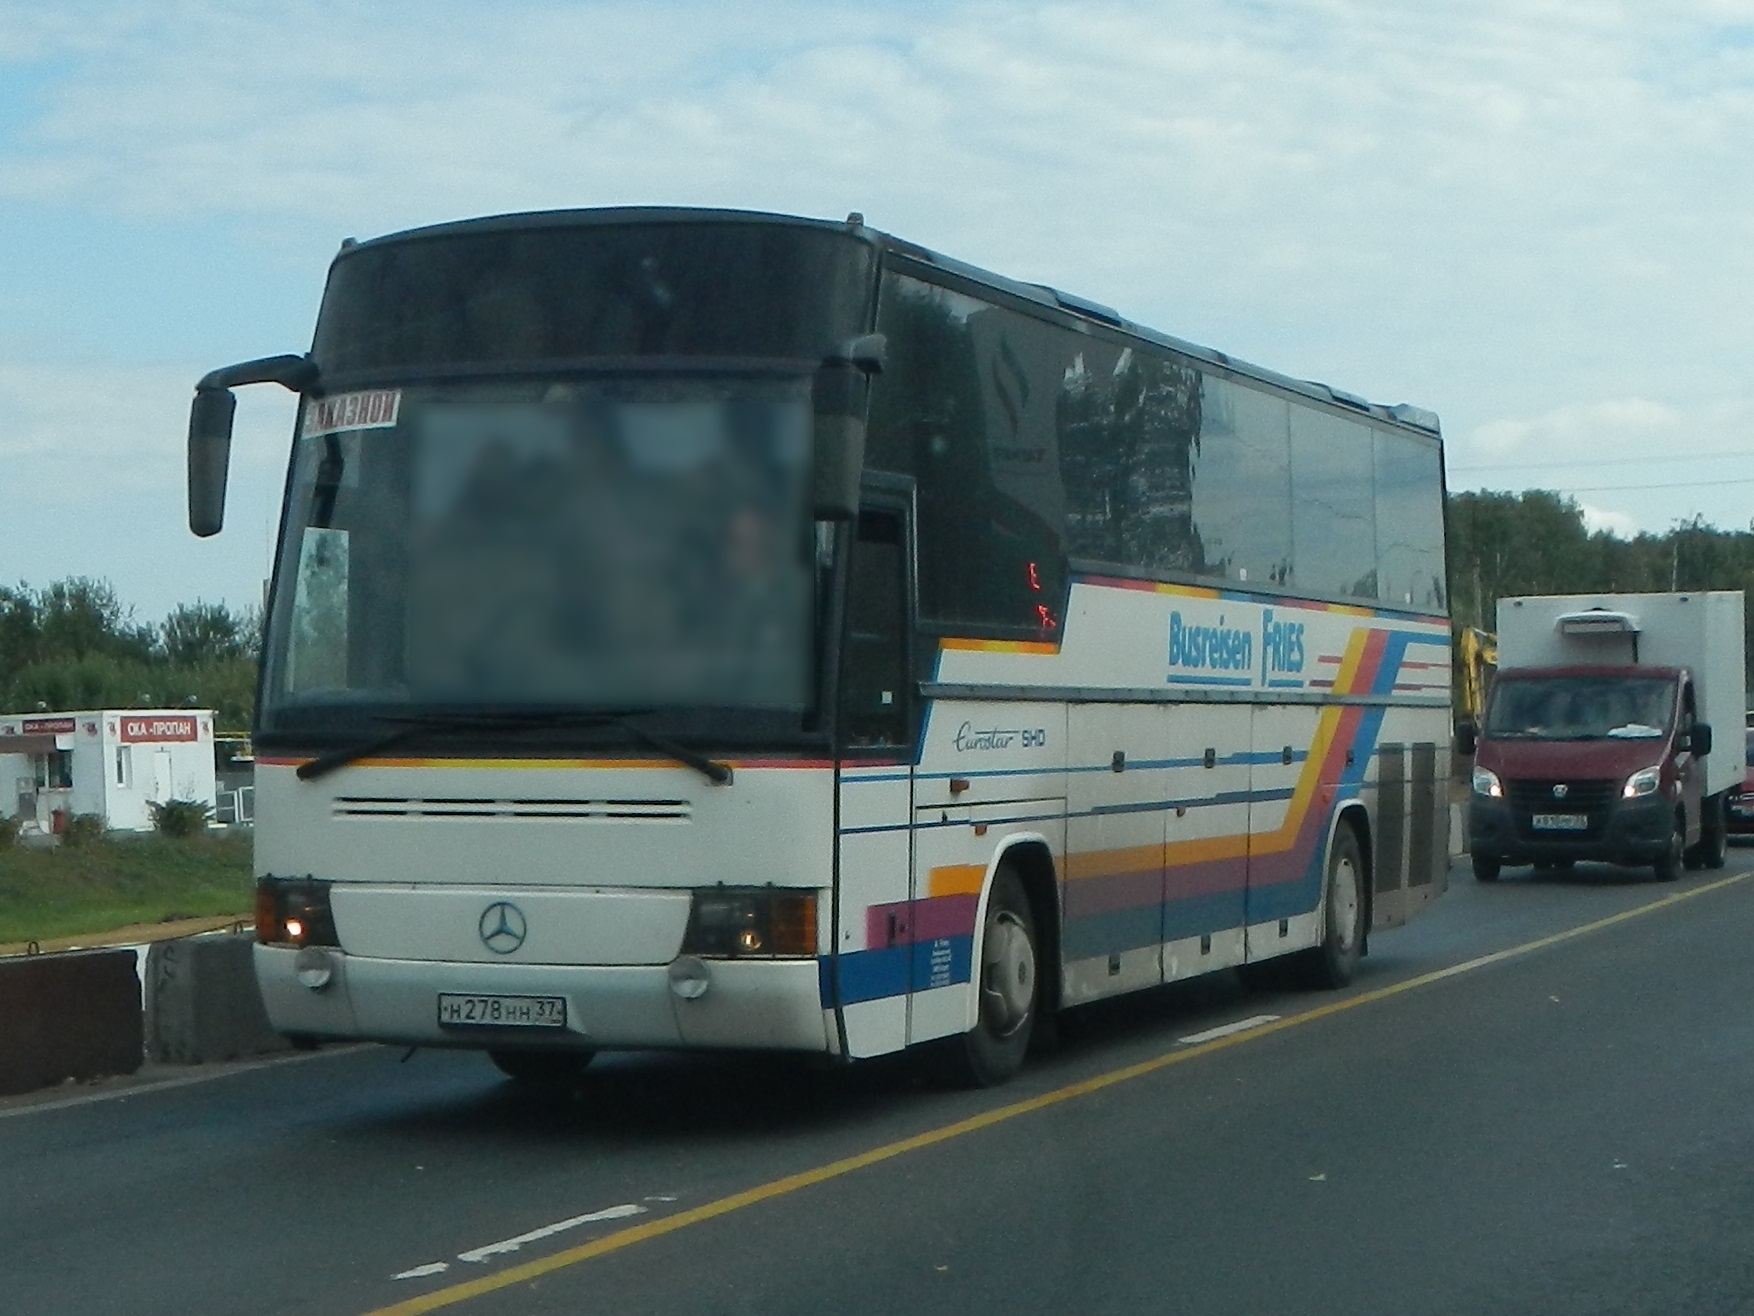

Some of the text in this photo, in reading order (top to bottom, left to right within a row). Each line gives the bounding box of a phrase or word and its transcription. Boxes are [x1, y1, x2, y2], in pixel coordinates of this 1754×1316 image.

[1168, 608, 1304, 688] Busreisen FRIES
[127, 722, 147, 736] ОКА
[952, 720, 1046, 752] Eurostar SHD
